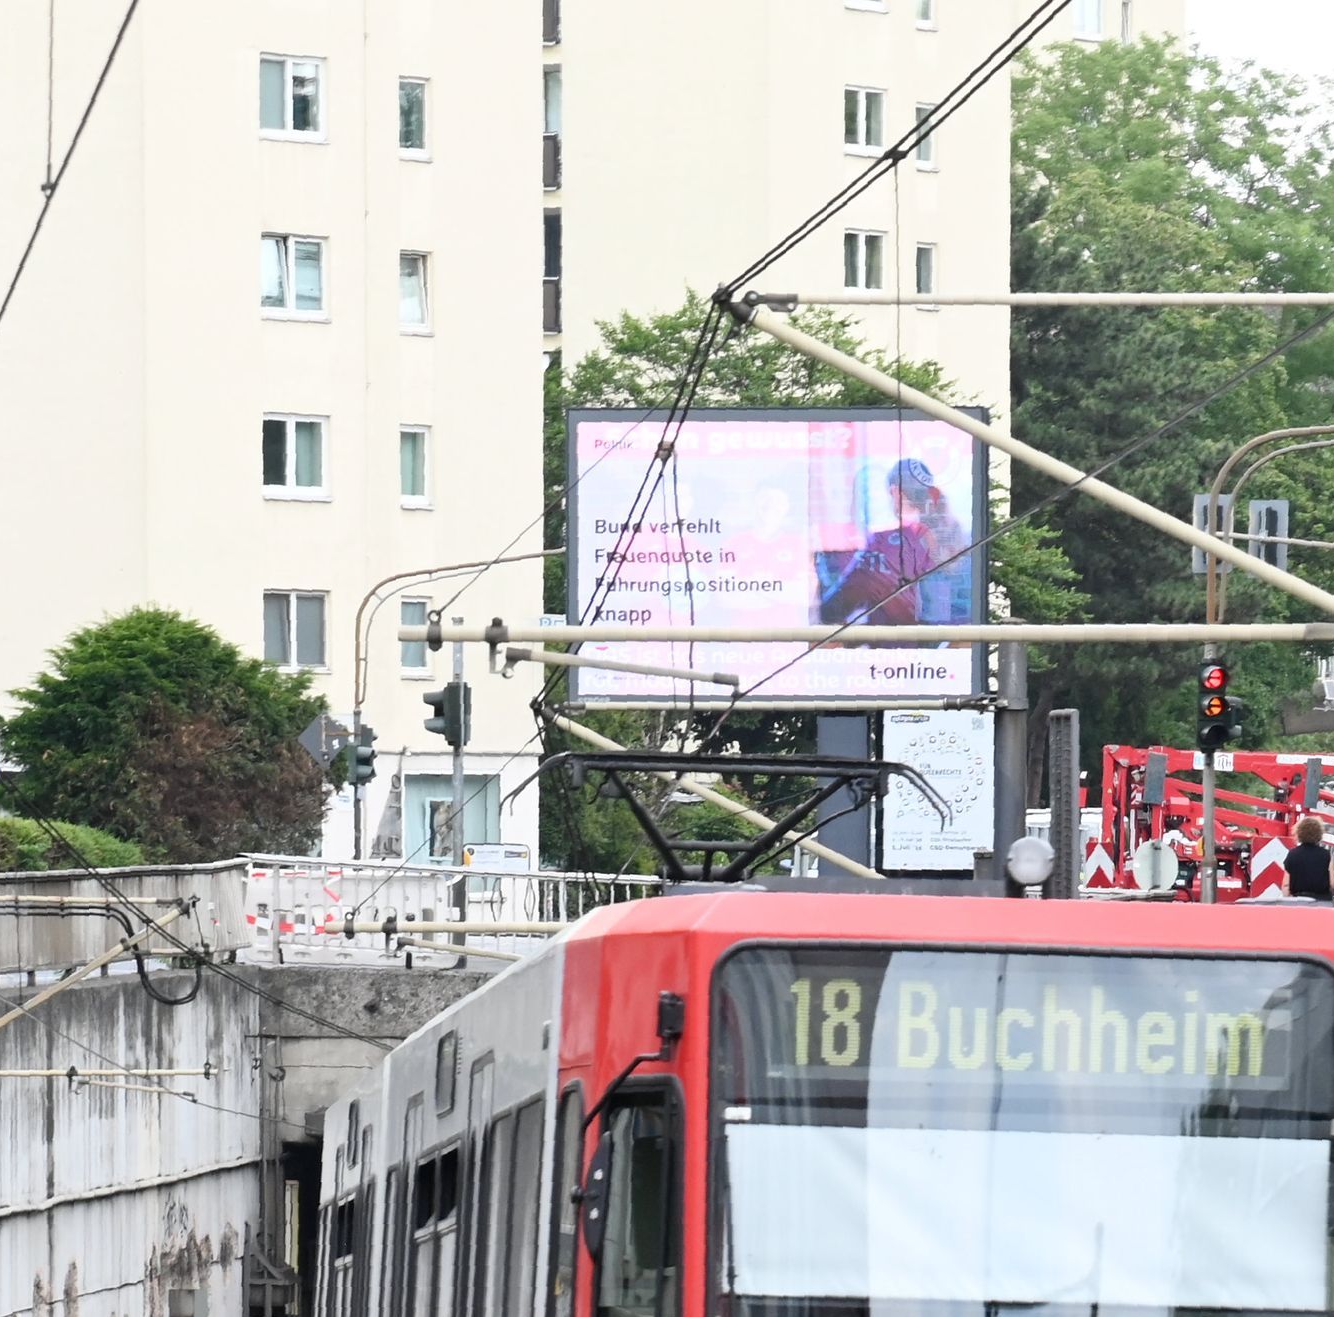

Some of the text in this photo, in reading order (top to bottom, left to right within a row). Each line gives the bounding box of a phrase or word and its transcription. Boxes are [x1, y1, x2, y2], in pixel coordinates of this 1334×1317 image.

[595, 518, 721, 534] Bund verfehlt
[594, 549, 736, 564] Frauenquote in
[594, 576, 783, 597] Führungspositionen
[594, 606, 652, 626] knapp
[789, 978, 1264, 1077] 18 Buchheim
